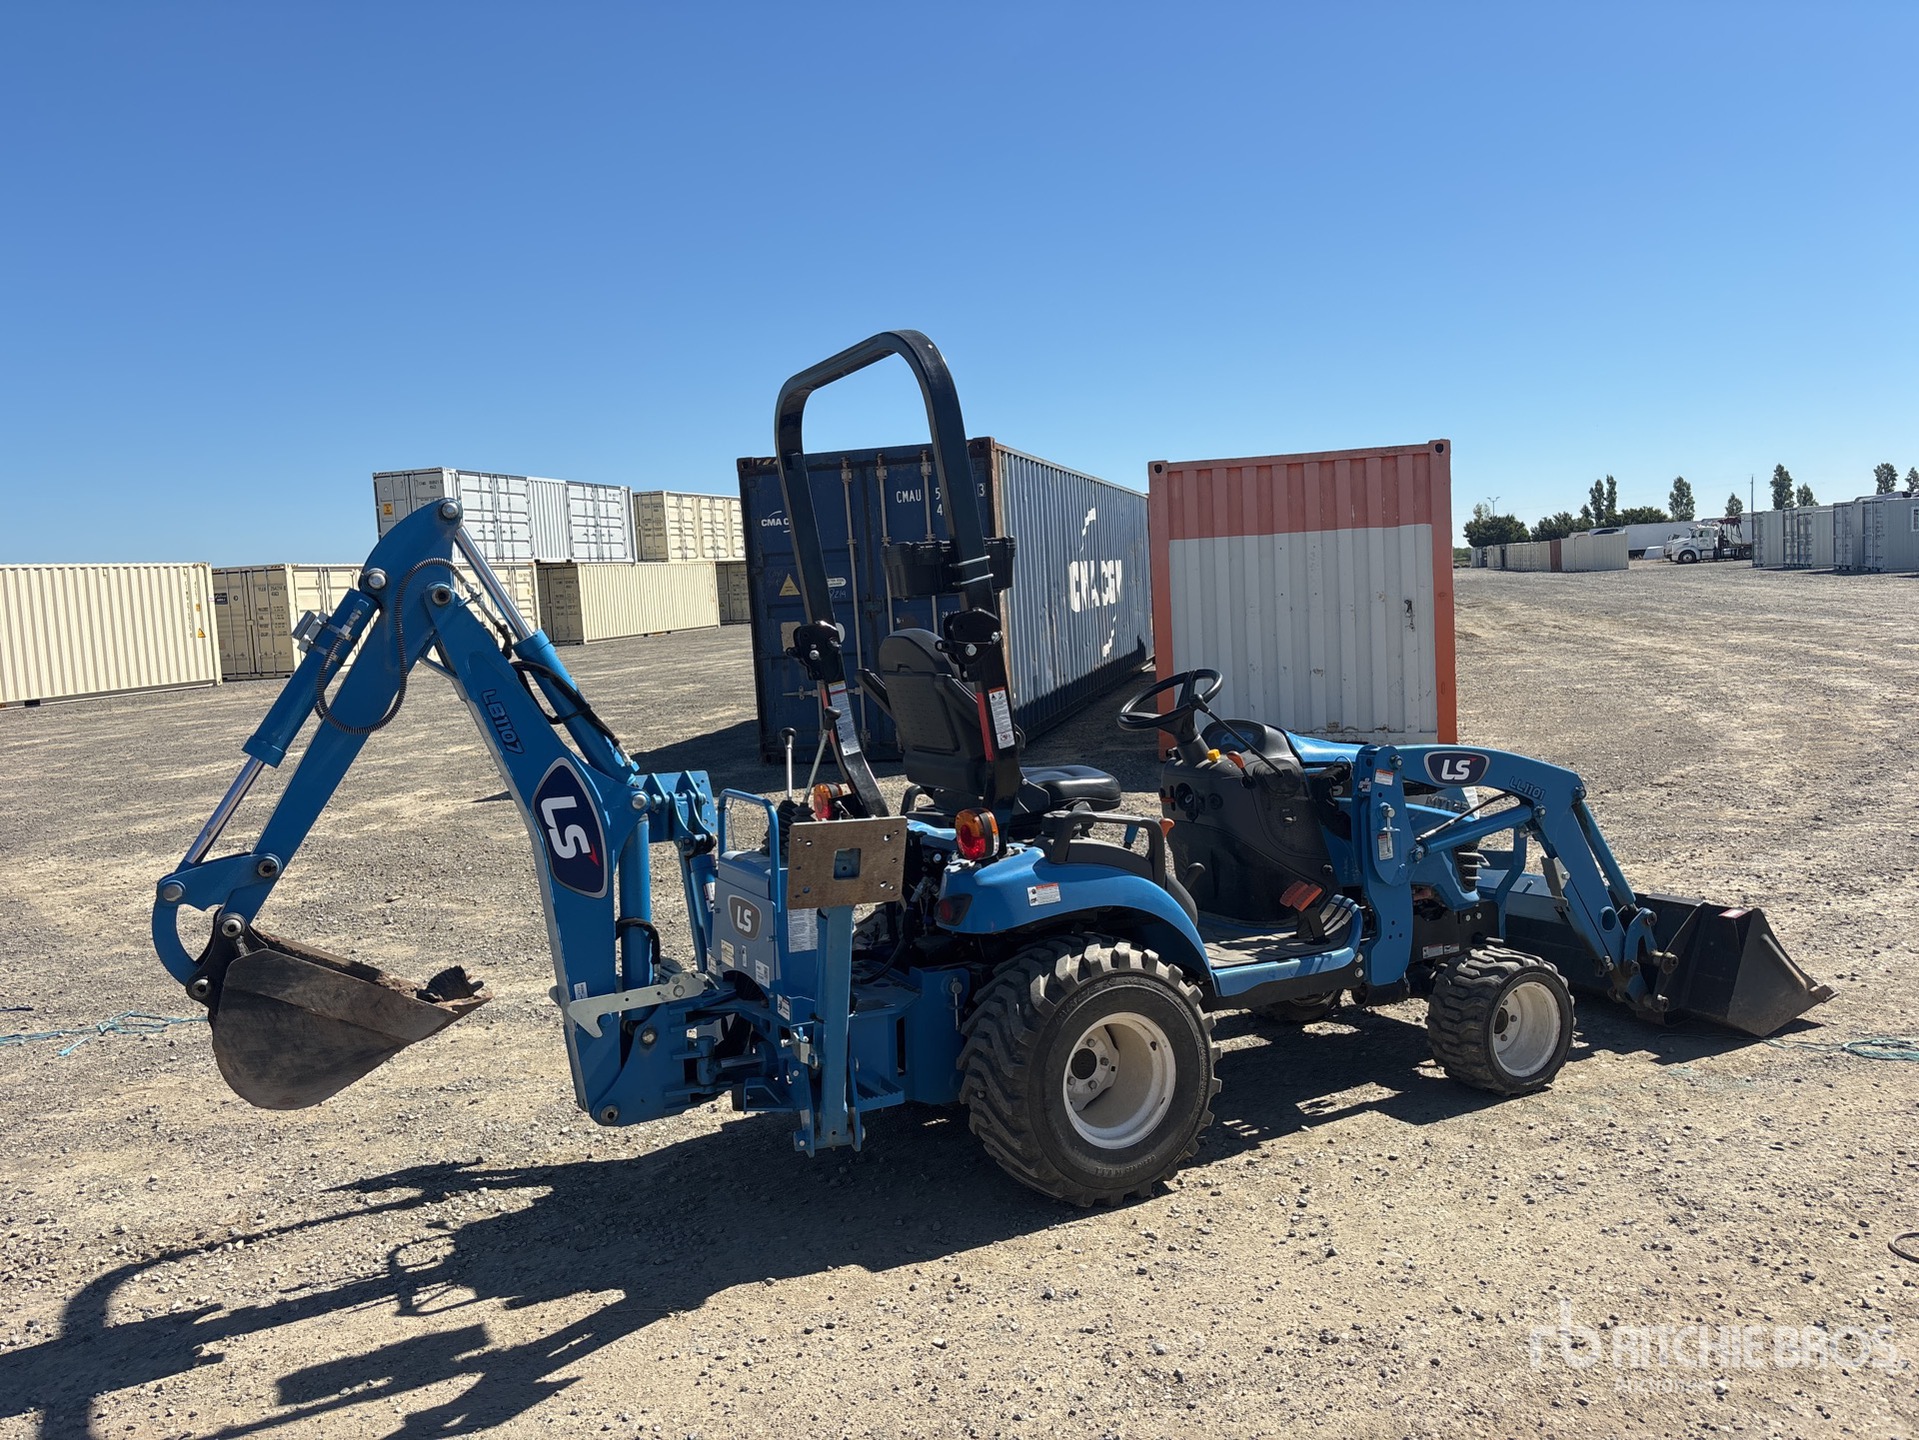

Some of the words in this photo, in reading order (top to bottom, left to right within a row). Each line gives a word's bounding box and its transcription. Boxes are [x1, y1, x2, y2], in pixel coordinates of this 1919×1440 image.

[896, 489, 922, 503] CMAU
[761, 518, 782, 527] CMA
[482, 689, 524, 754] LB1107
[1441, 759, 1471, 780] LS
[1509, 776, 1546, 801] LL1101
[540, 795, 592, 859] LS
[737, 905, 752, 933] LS
